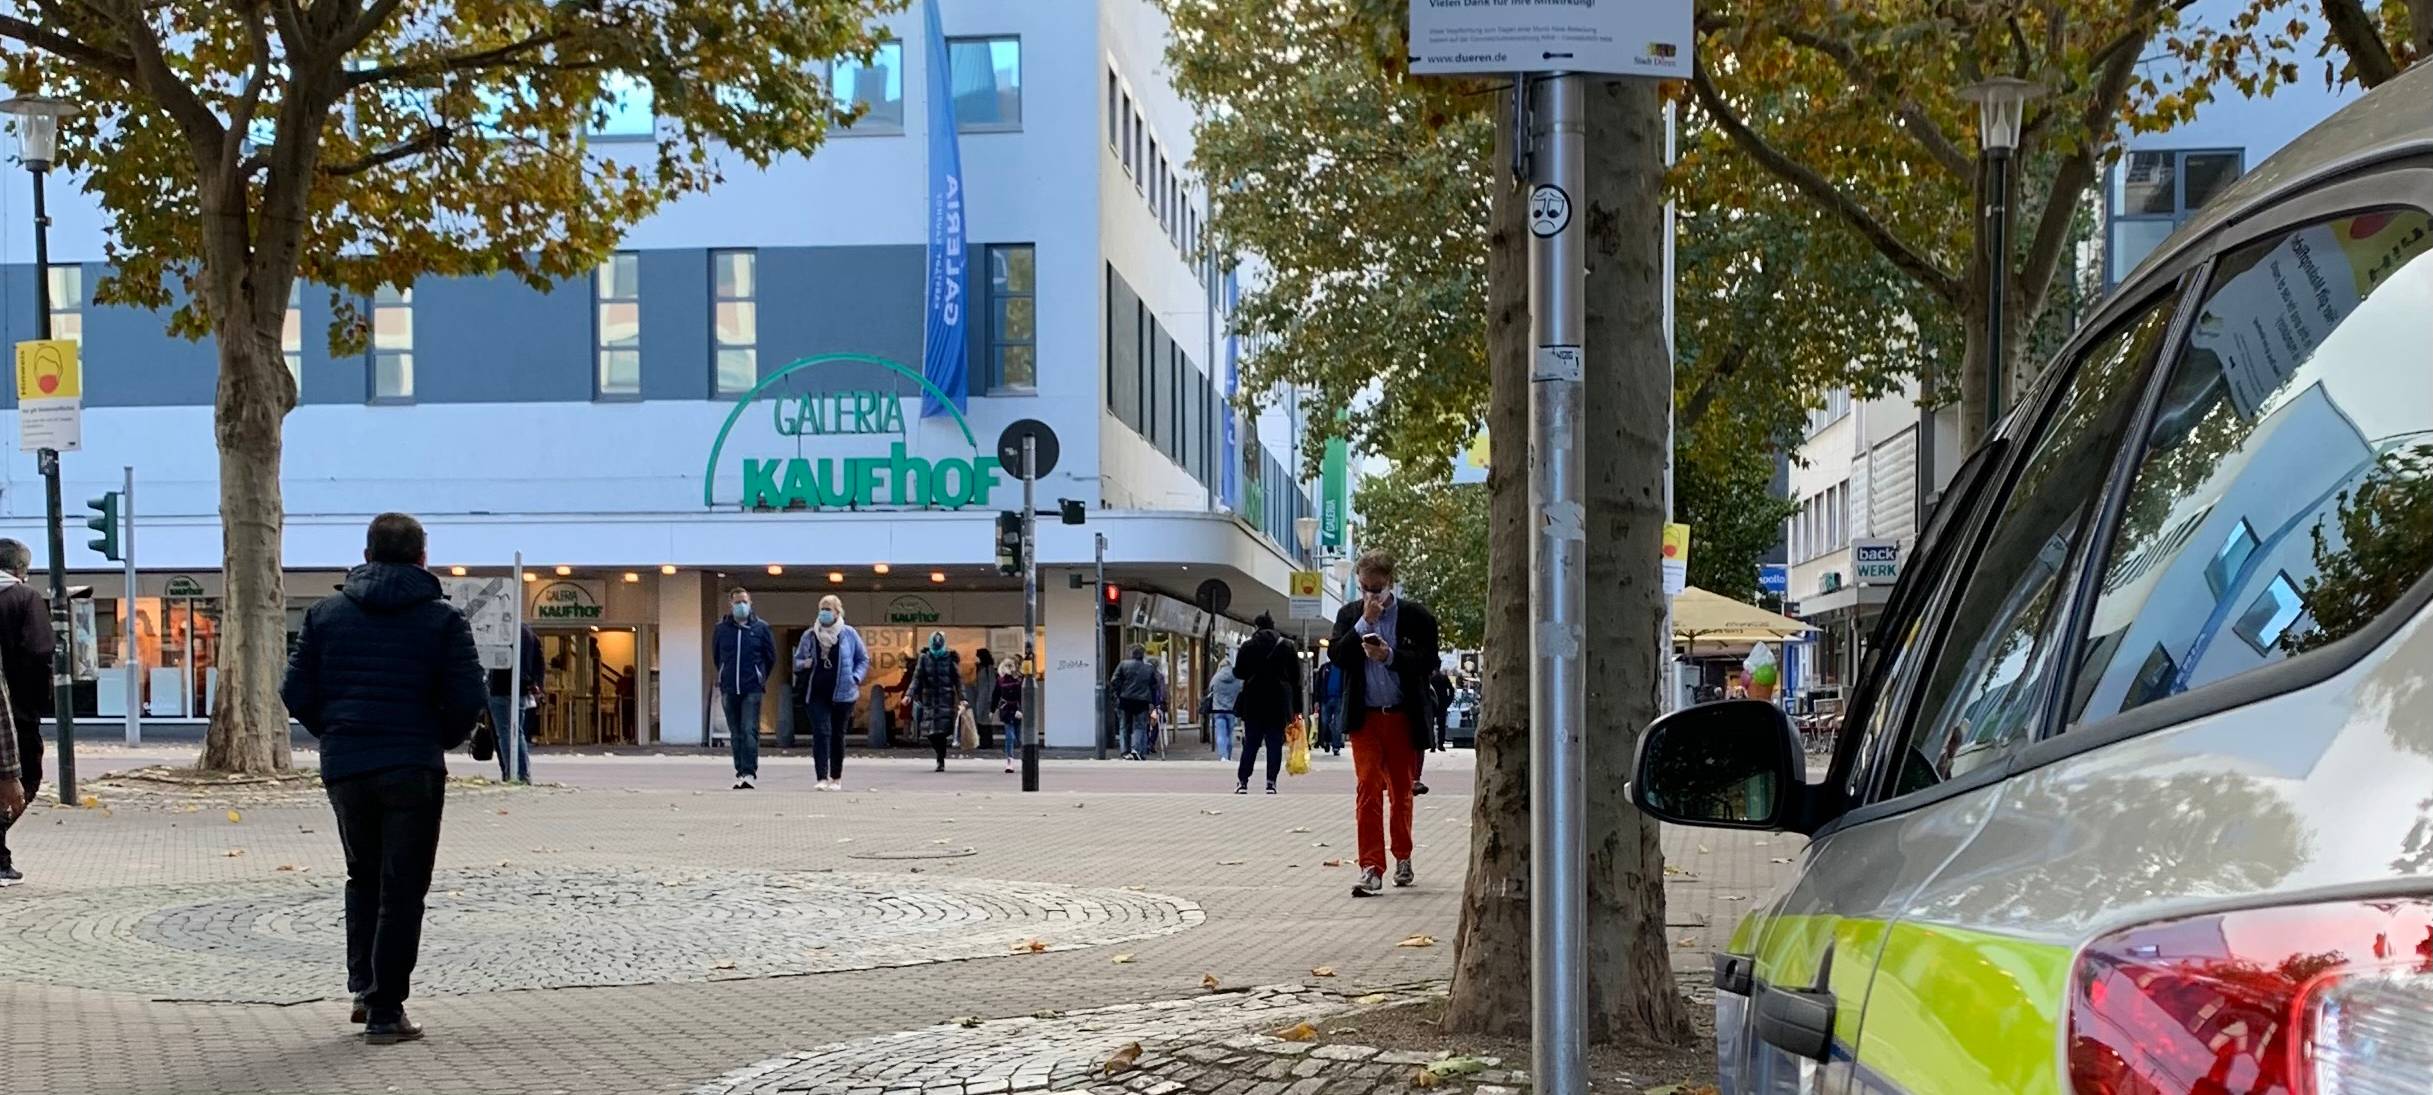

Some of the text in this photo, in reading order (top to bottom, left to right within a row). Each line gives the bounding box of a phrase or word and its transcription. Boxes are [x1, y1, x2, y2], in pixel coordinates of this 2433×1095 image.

[1428, 52, 1507, 63] www.dueren.de
[774, 391, 905, 435] GALERIA
[1326, 500, 1336, 532] GALERIA
[1859, 547, 1895, 560] back
[1858, 564, 1897, 577] WERK
[546, 590, 578, 602] GALERIA
